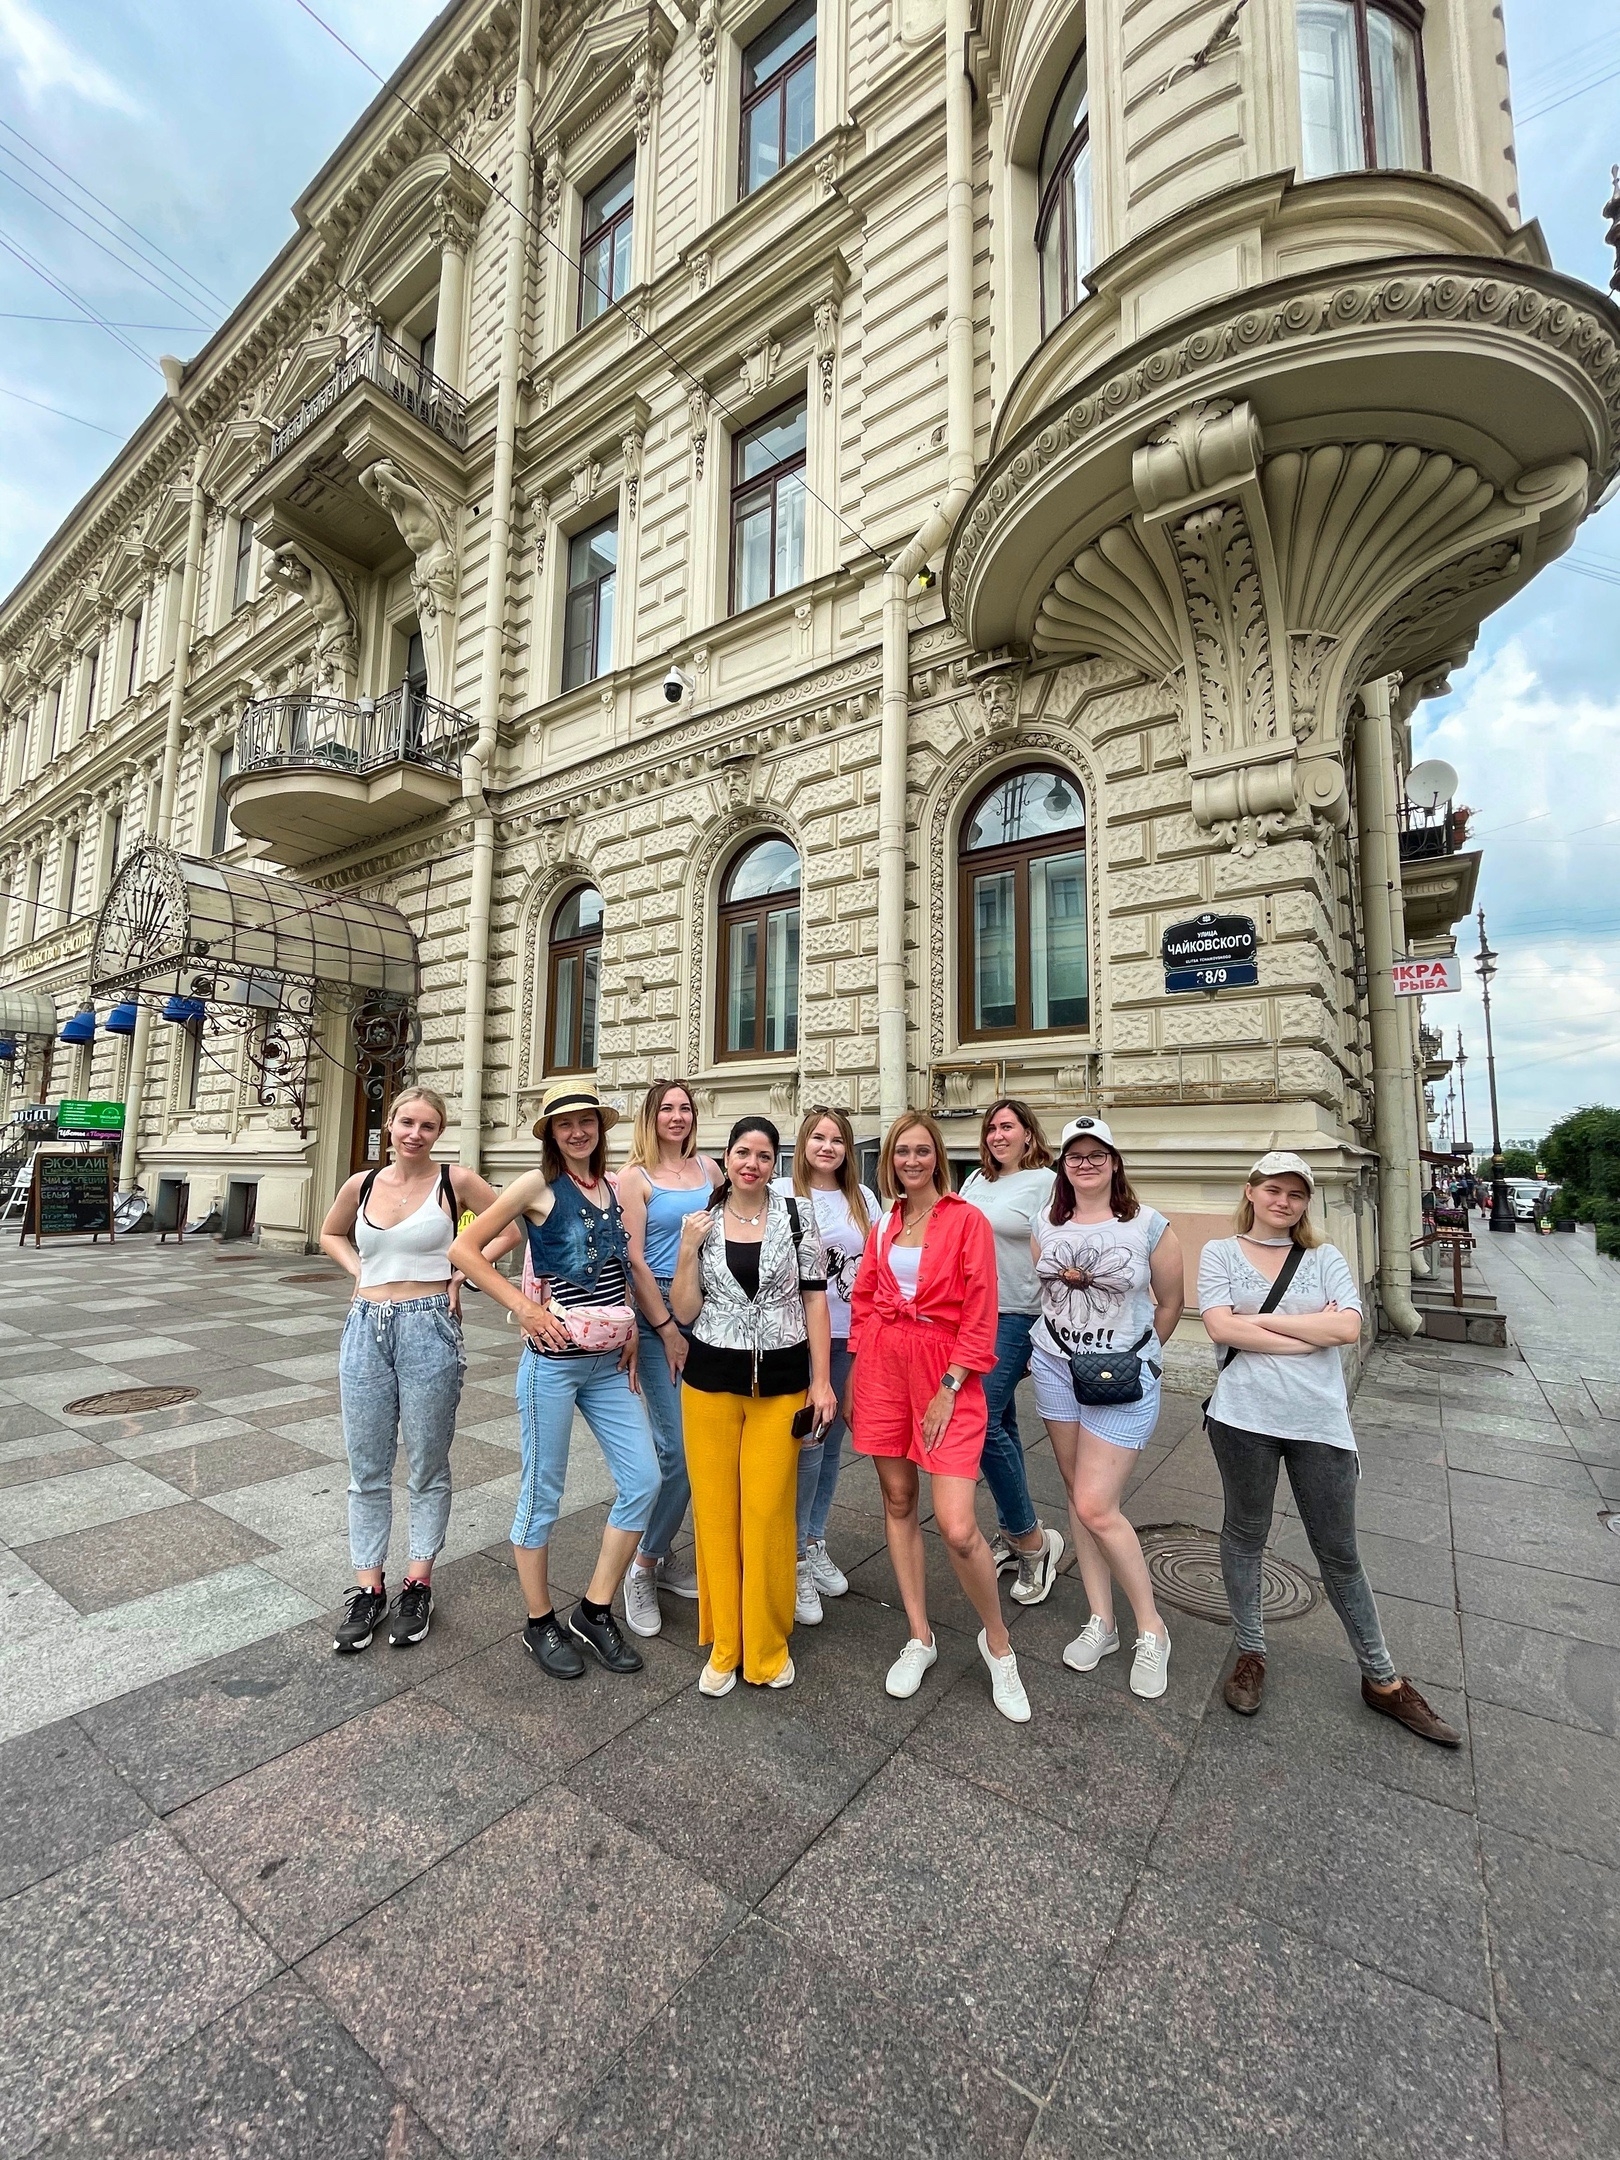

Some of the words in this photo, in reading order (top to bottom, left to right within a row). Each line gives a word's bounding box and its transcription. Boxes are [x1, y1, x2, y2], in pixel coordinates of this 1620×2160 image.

[1197, 930, 1218, 938] УЛИЦА
[1167, 934, 1251, 955] ЧАЙКОВСКОГО
[1399, 978, 1448, 991] РЫБА
